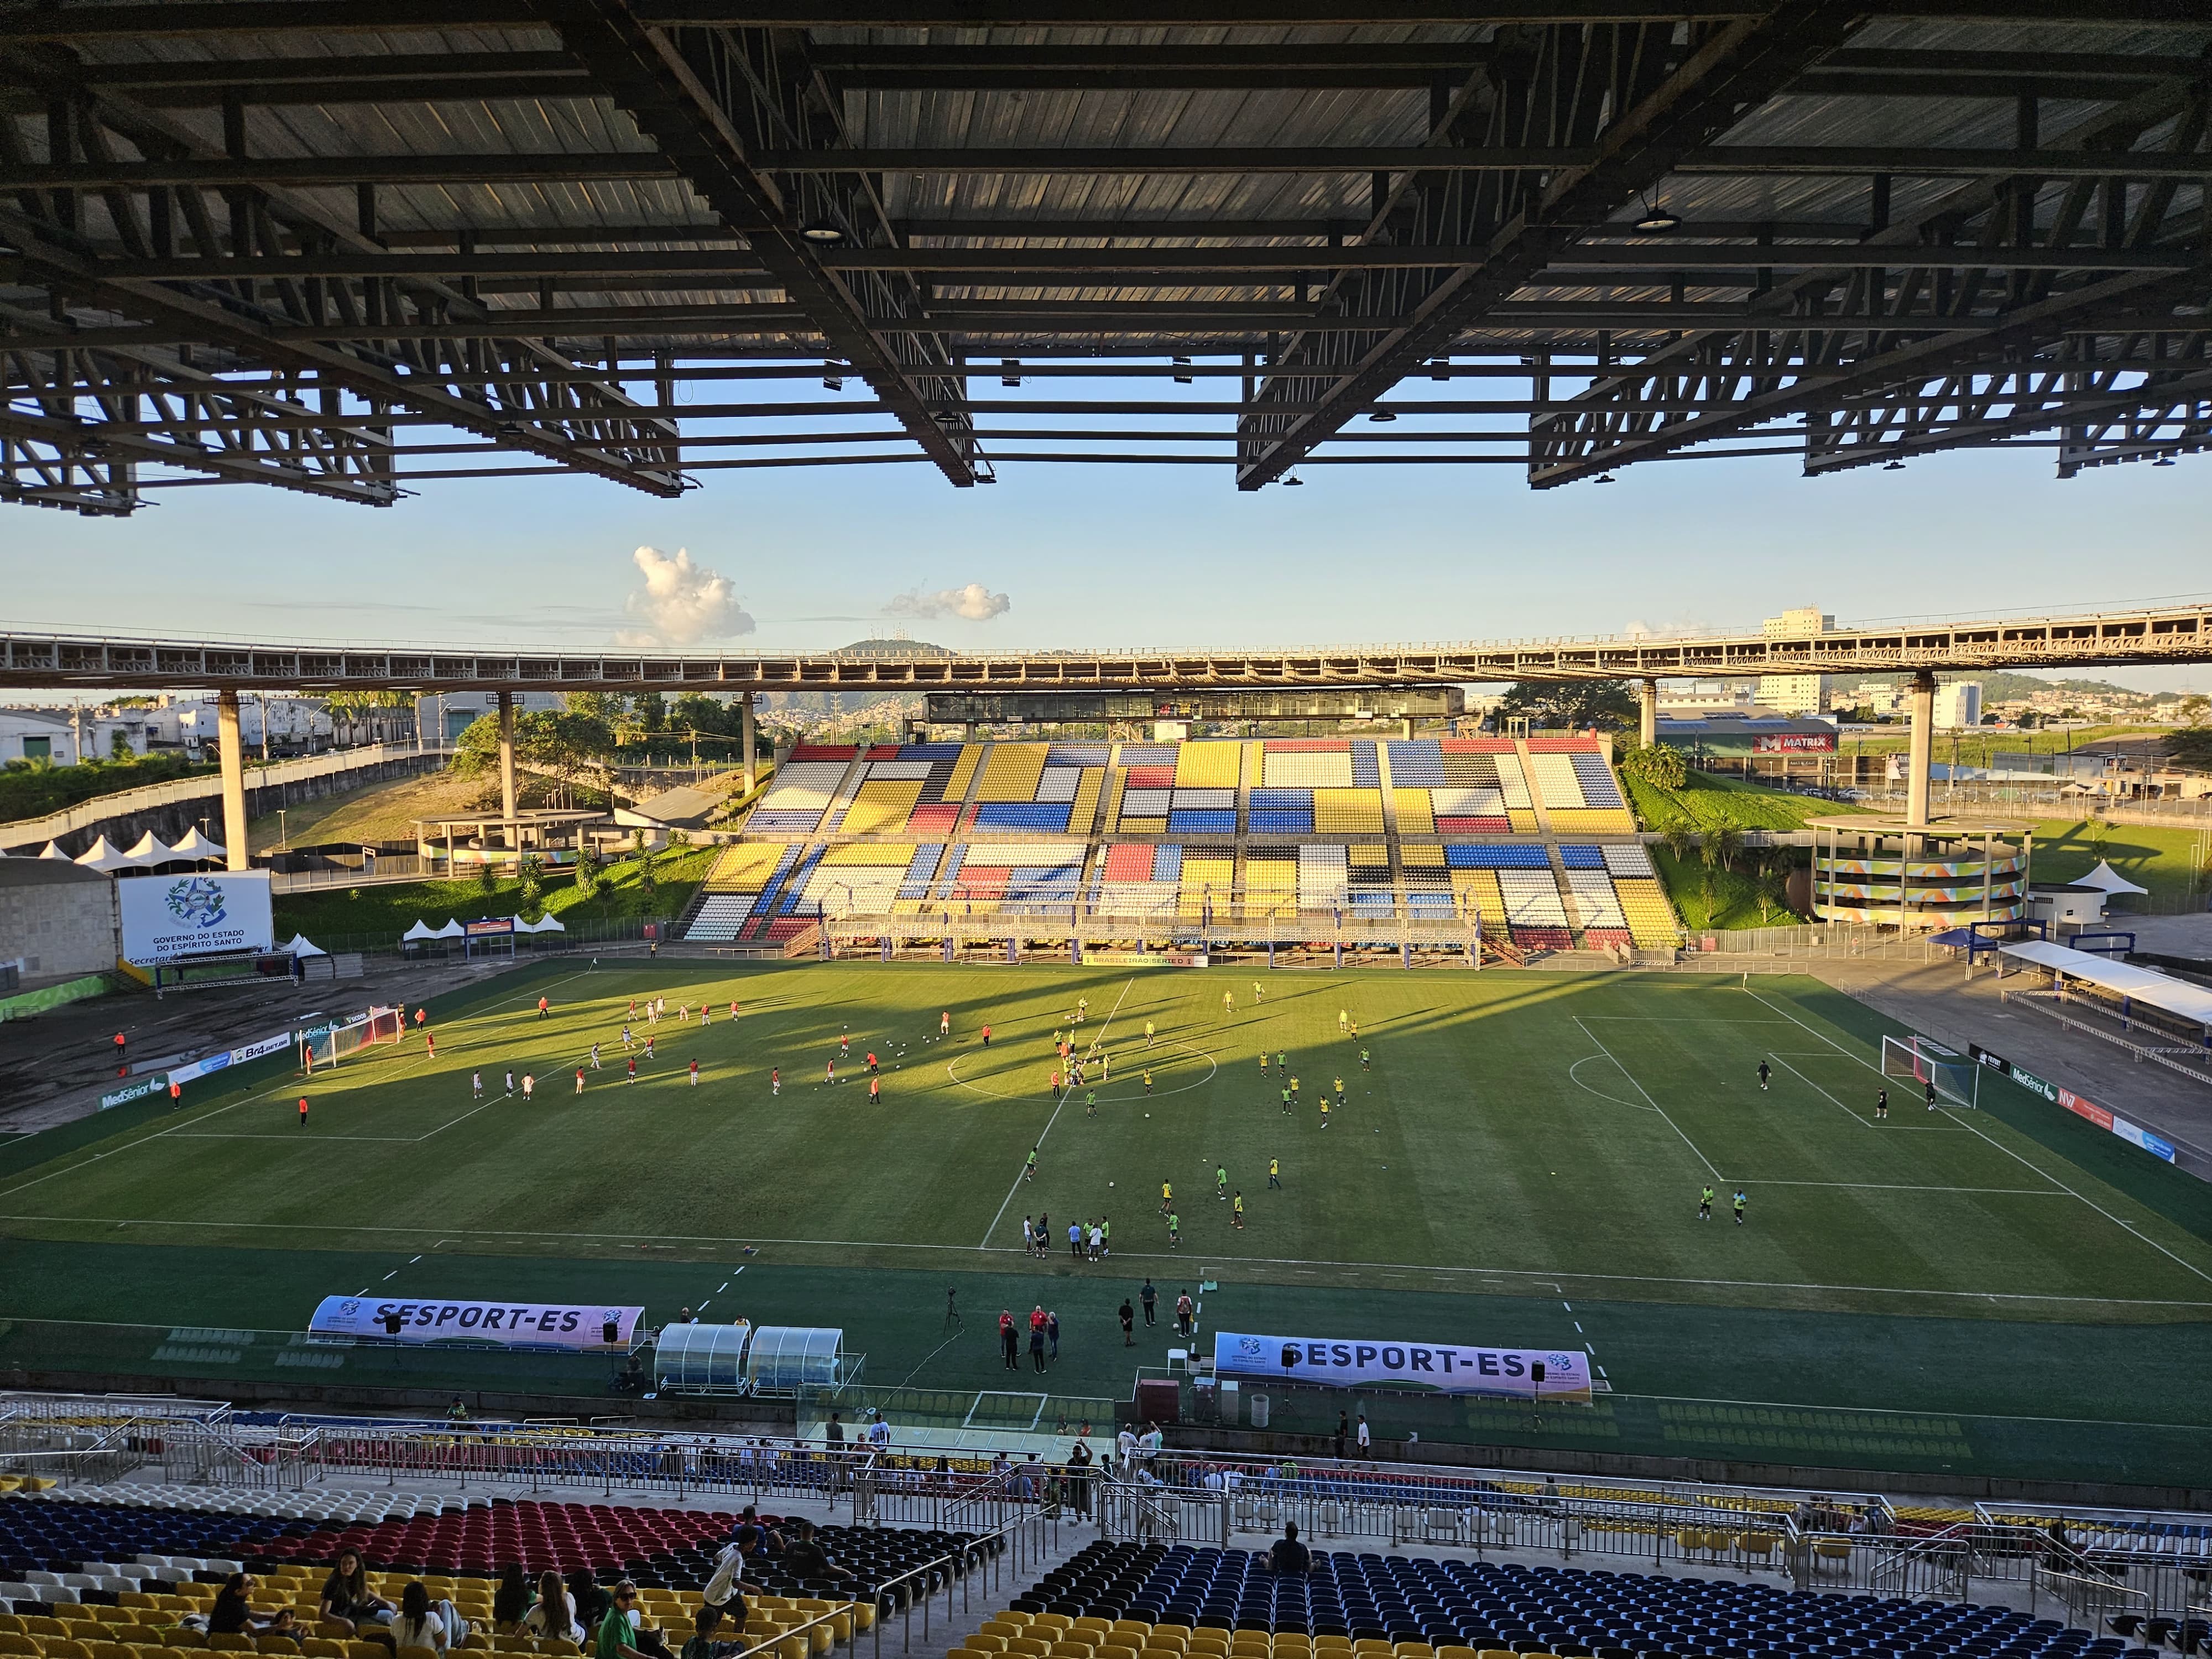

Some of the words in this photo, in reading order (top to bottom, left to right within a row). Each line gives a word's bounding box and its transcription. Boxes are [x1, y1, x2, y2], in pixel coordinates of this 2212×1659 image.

[1783, 738, 1825, 747] MATRIX
[153, 934, 195, 944] GOVERNO
[212, 930, 244, 938] ESTADO
[172, 941, 212, 950] ESPÍRITO
[215, 938, 242, 946] SANTO
[128, 954, 173, 966] Secretari
[351, 1013, 367, 1022] SICOOB
[294, 1025, 328, 1042] MedSênior
[2012, 1068, 2044, 1093] MedSênior
[102, 1084, 149, 1108] MedSênior
[372, 1303, 581, 1332] SESPORT-ES
